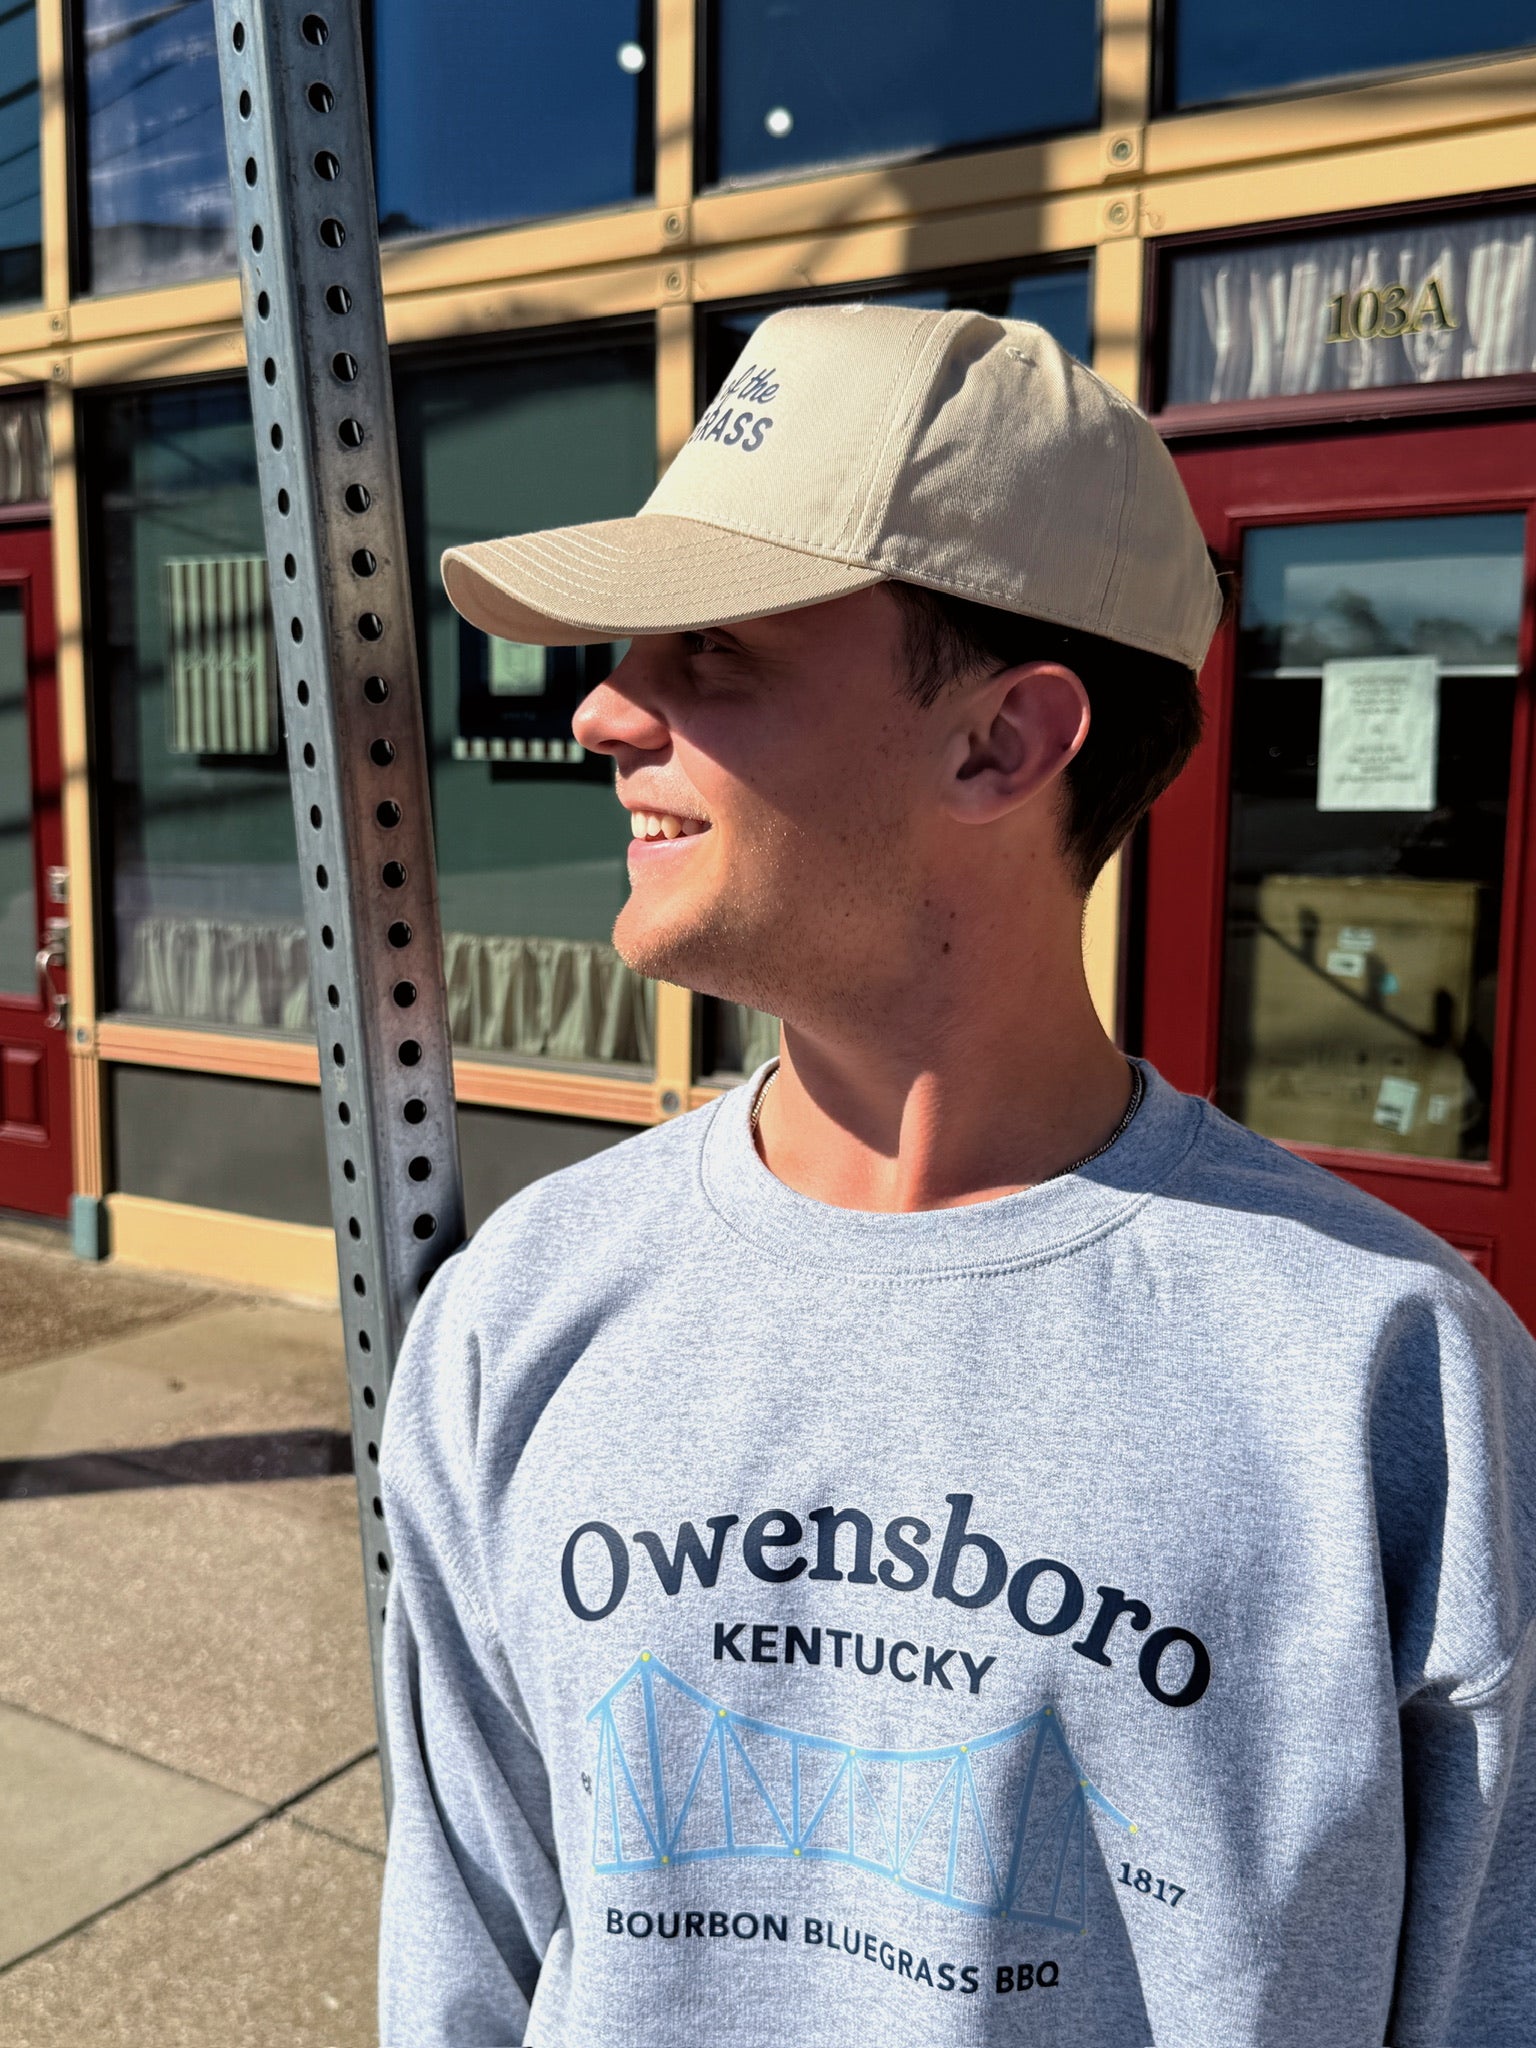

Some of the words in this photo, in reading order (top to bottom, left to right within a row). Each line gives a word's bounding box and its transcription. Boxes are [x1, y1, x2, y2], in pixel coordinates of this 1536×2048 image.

[1325, 279, 1458, 343] 103A
[737, 367, 780, 404] the
[561, 1493, 1211, 1708] Owensboro
[713, 1622, 997, 1695] KENTUCKY
[1118, 1861, 1186, 1908] 1817
[606, 1906, 788, 1942] BOURBON
[804, 1916, 980, 1995] BLUEGRASS
[995, 1960, 1060, 1994] BBQ
